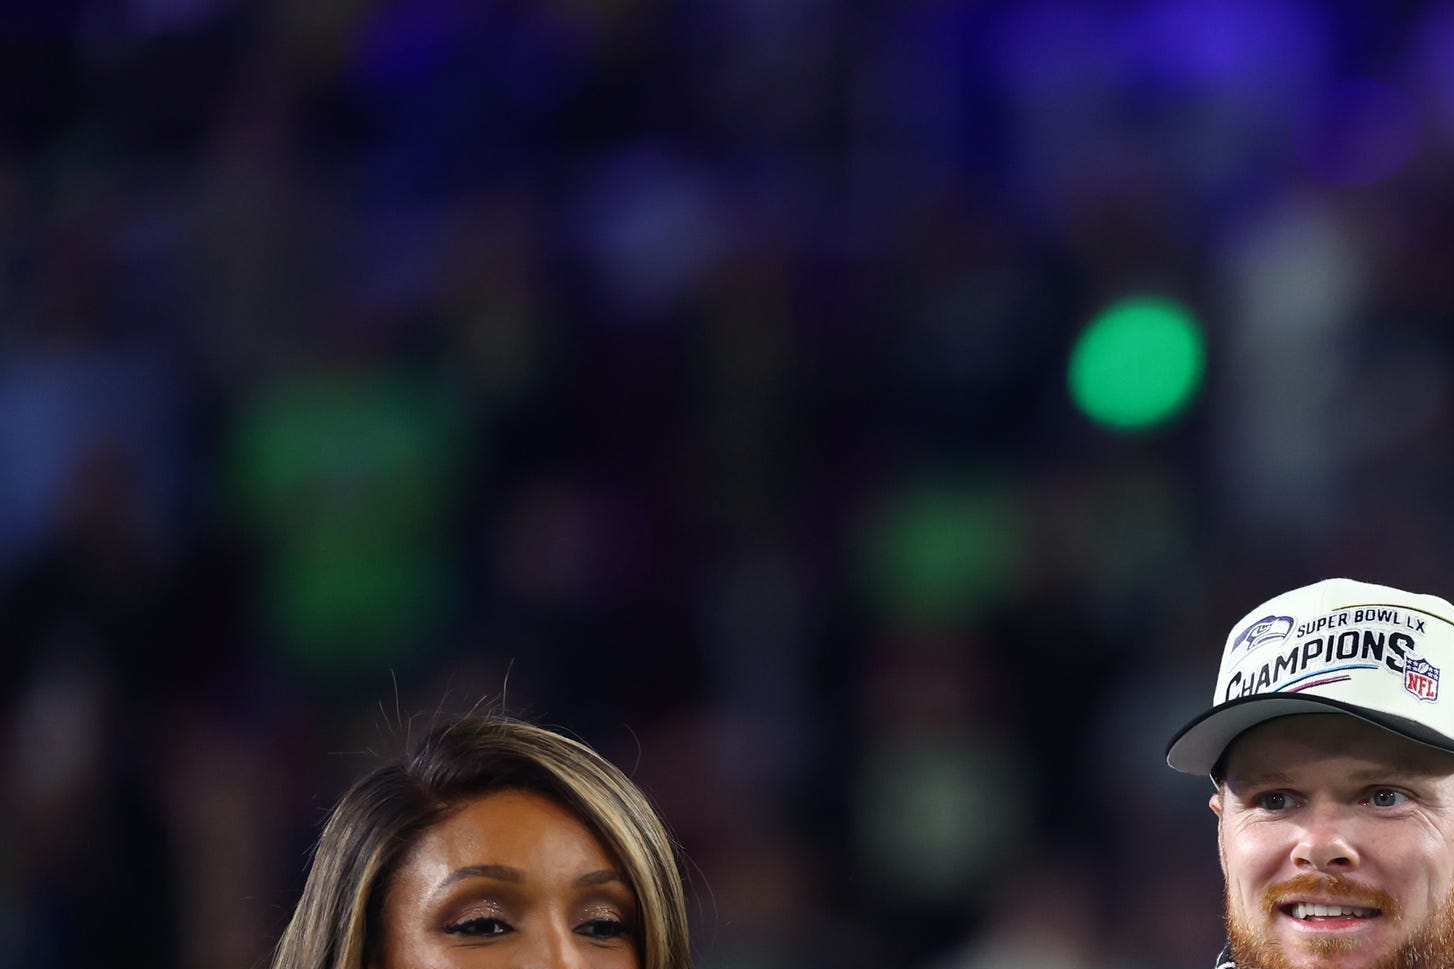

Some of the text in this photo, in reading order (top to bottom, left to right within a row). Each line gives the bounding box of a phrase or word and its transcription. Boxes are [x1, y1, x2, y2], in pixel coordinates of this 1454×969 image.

[1297, 609, 1426, 638] SUPER BOWL LX
[1225, 630, 1415, 700] CHAMPIONS
[1407, 672, 1434, 698] NFL
